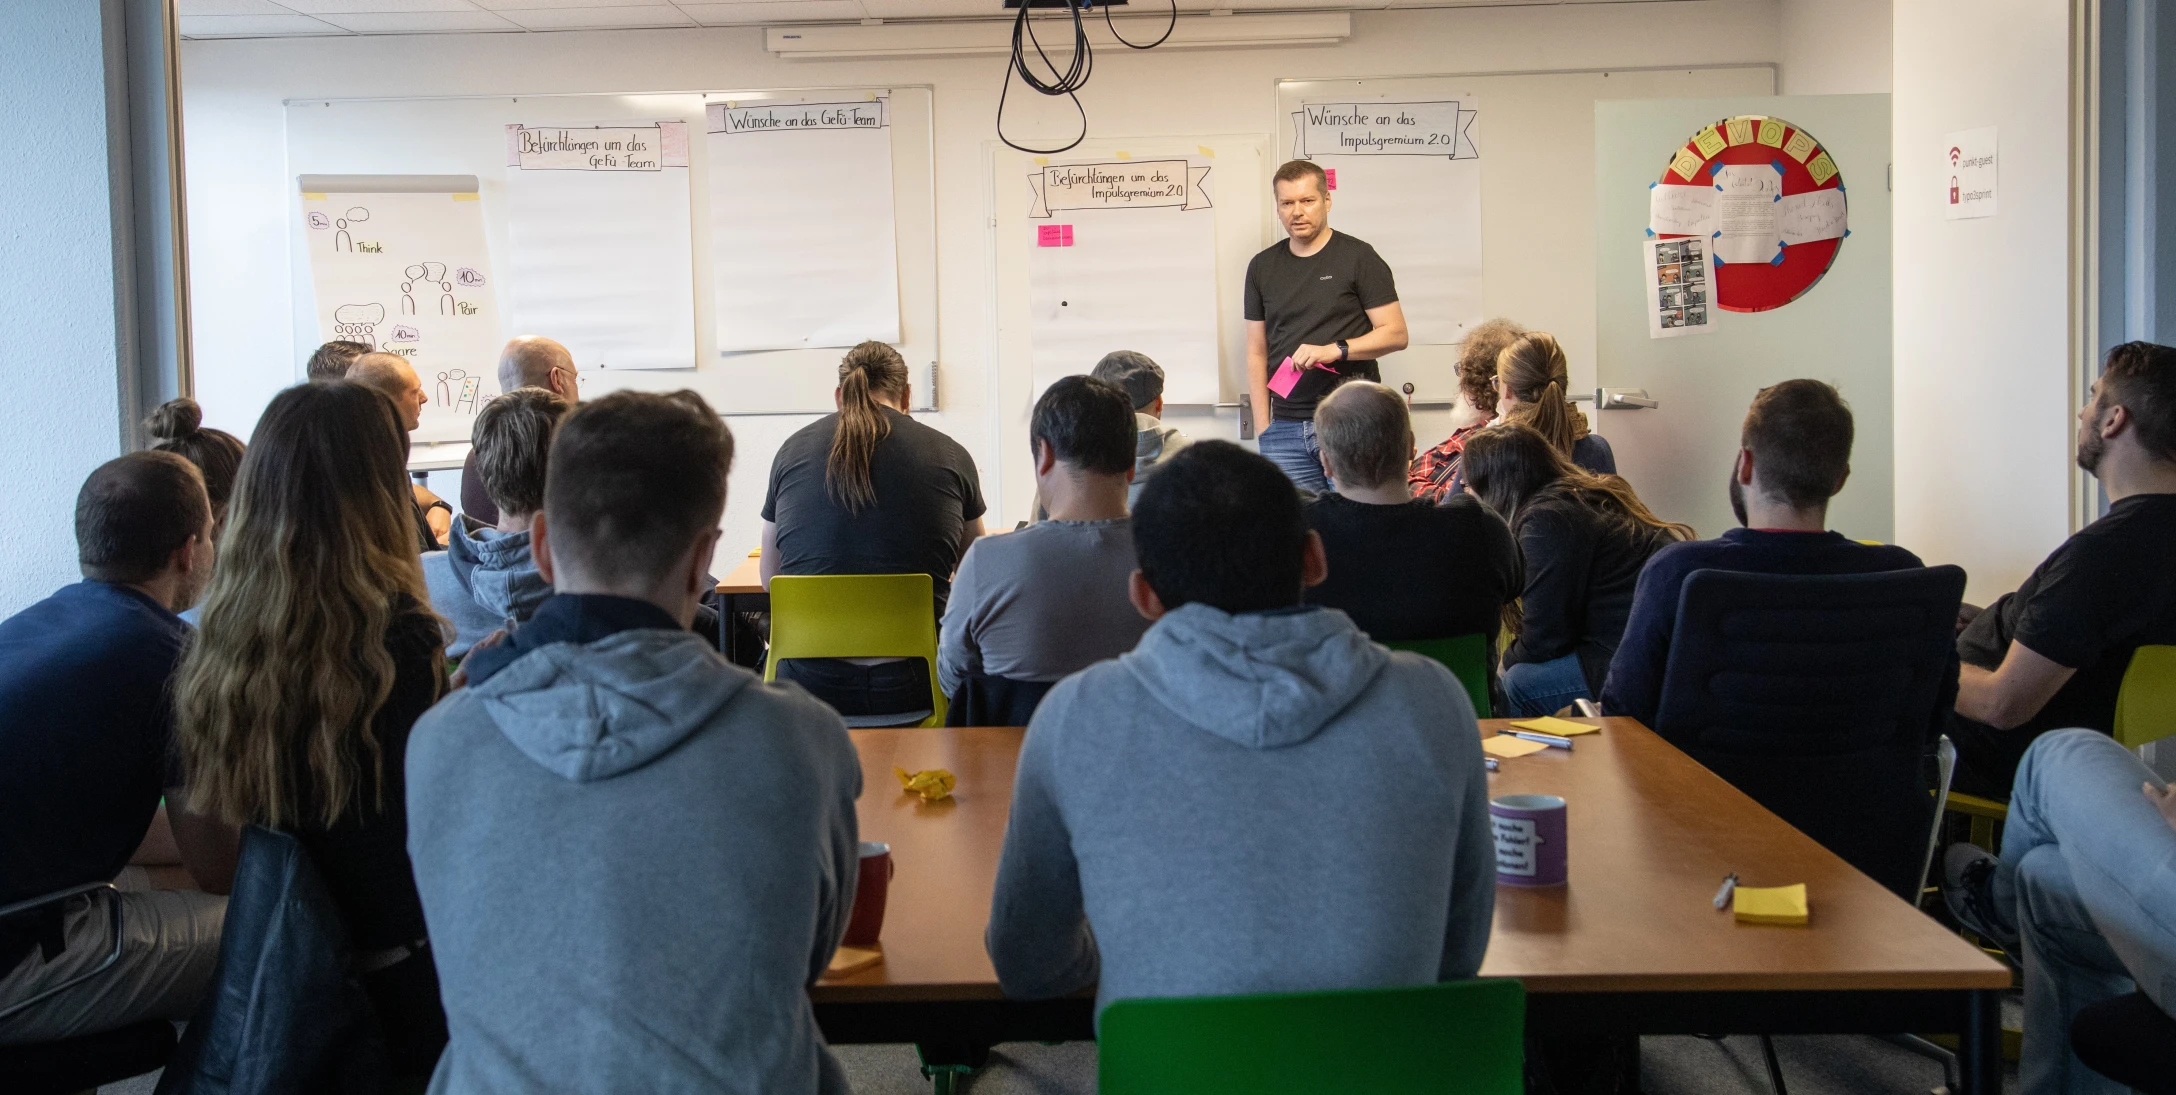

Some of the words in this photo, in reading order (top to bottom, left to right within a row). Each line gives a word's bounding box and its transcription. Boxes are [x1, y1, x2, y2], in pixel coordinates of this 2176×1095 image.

[729, 110, 781, 130] Wünsche
[785, 119, 798, 127] an
[801, 112, 817, 126] das
[1308, 105, 1369, 125] Wünsche
[1376, 116, 1391, 125] an
[1397, 112, 1416, 125] das
[604, 141, 621, 151] um
[627, 134, 647, 151] das
[1341, 131, 1424, 152] Impulsgremium
[1427, 133, 1451, 145] 2.0
[1131, 174, 1146, 182] um
[1151, 170, 1169, 182] das
[1092, 186, 1165, 203] Impulsgremium
[1165, 184, 1184, 197] 2.0
[356, 242, 383, 253] Think
[457, 301, 479, 315] Pair
